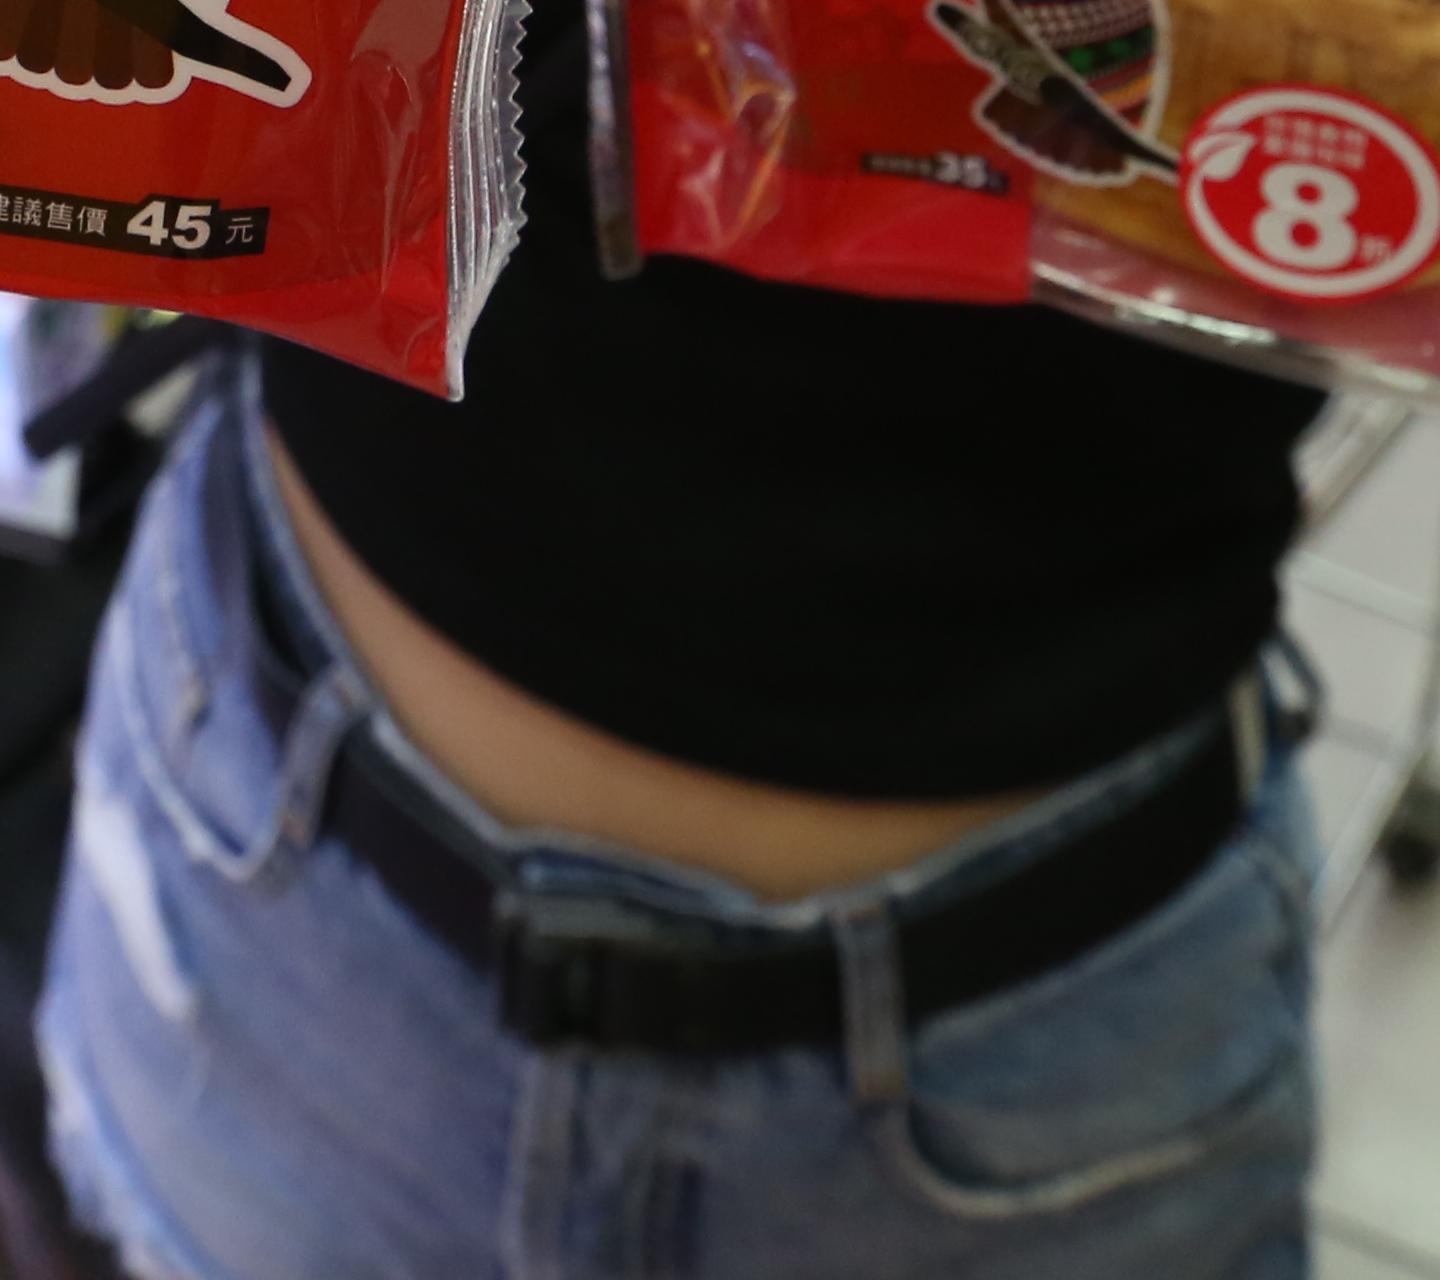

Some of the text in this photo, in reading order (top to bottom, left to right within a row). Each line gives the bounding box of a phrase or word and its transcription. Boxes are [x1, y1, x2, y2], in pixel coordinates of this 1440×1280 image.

[125, 201, 212, 251] 45
[225, 216, 255, 244] 元
[1253, 163, 1360, 269] 8
